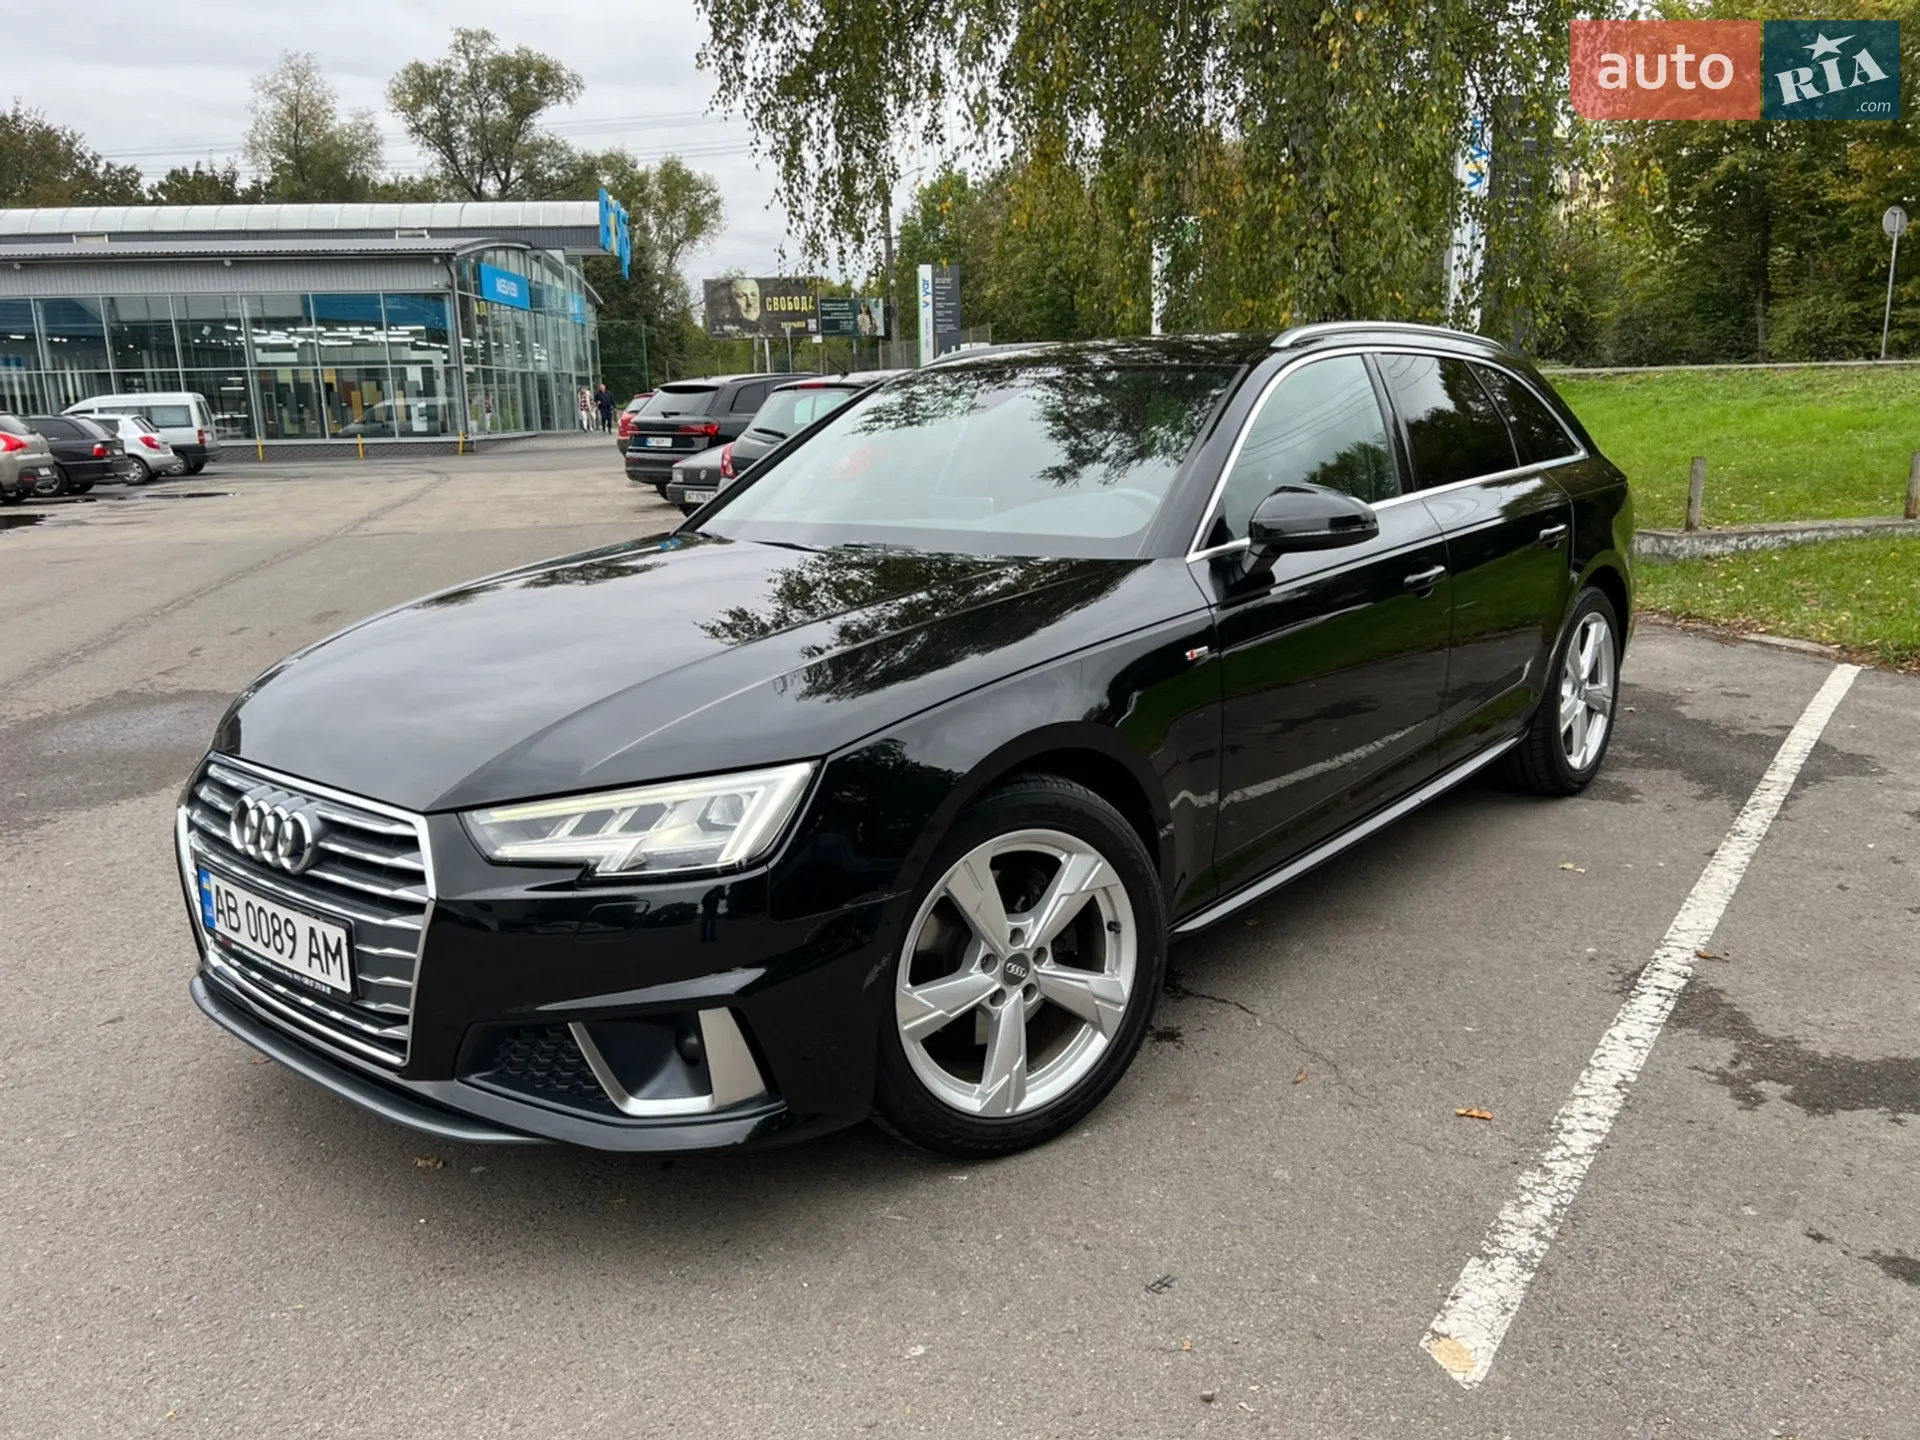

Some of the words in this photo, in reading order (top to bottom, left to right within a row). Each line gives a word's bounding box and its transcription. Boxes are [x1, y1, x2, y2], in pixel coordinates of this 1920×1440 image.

[922, 278, 932, 308] vyar
[215, 884, 241, 932] AB
[245, 900, 297, 960] 0089
[308, 926, 345, 982] AM
